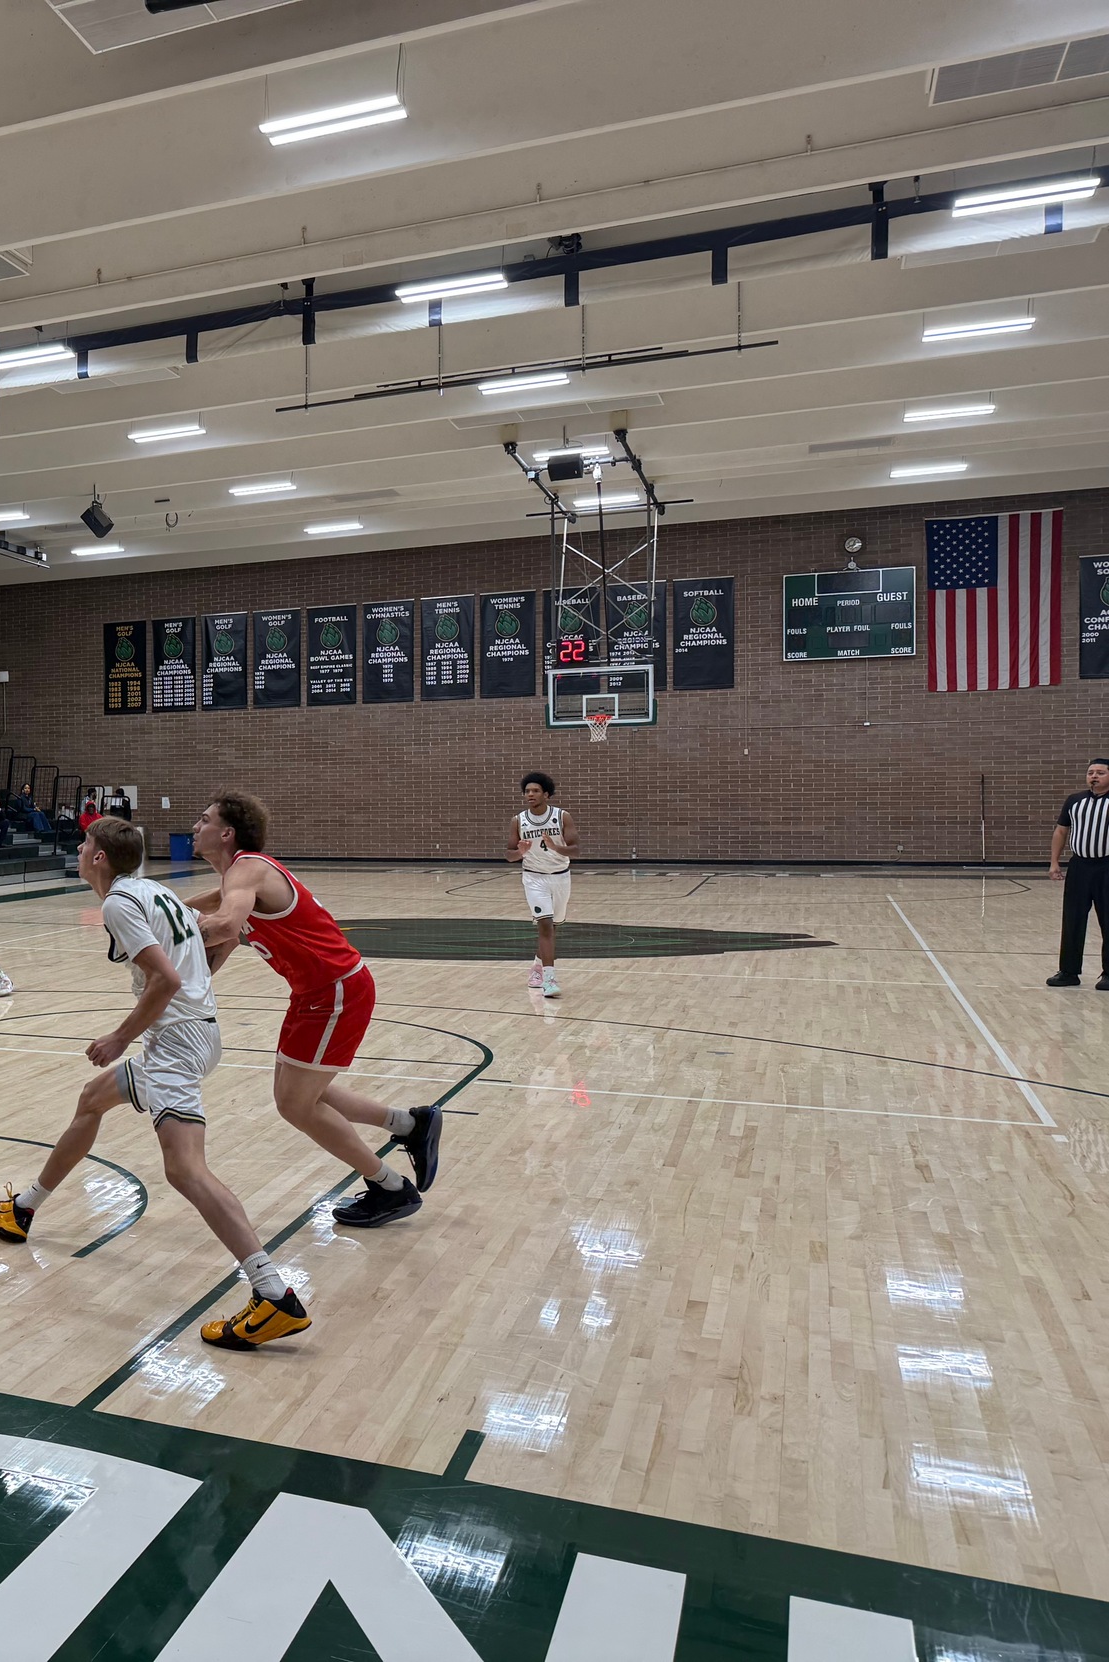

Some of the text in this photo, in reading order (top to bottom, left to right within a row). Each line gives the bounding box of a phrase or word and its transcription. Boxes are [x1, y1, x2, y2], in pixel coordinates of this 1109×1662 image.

[683, 589, 724, 598] SOFTBALL
[877, 592, 908, 602] GUEST
[792, 597, 818, 607] HOME
[560, 640, 584, 662] 22
